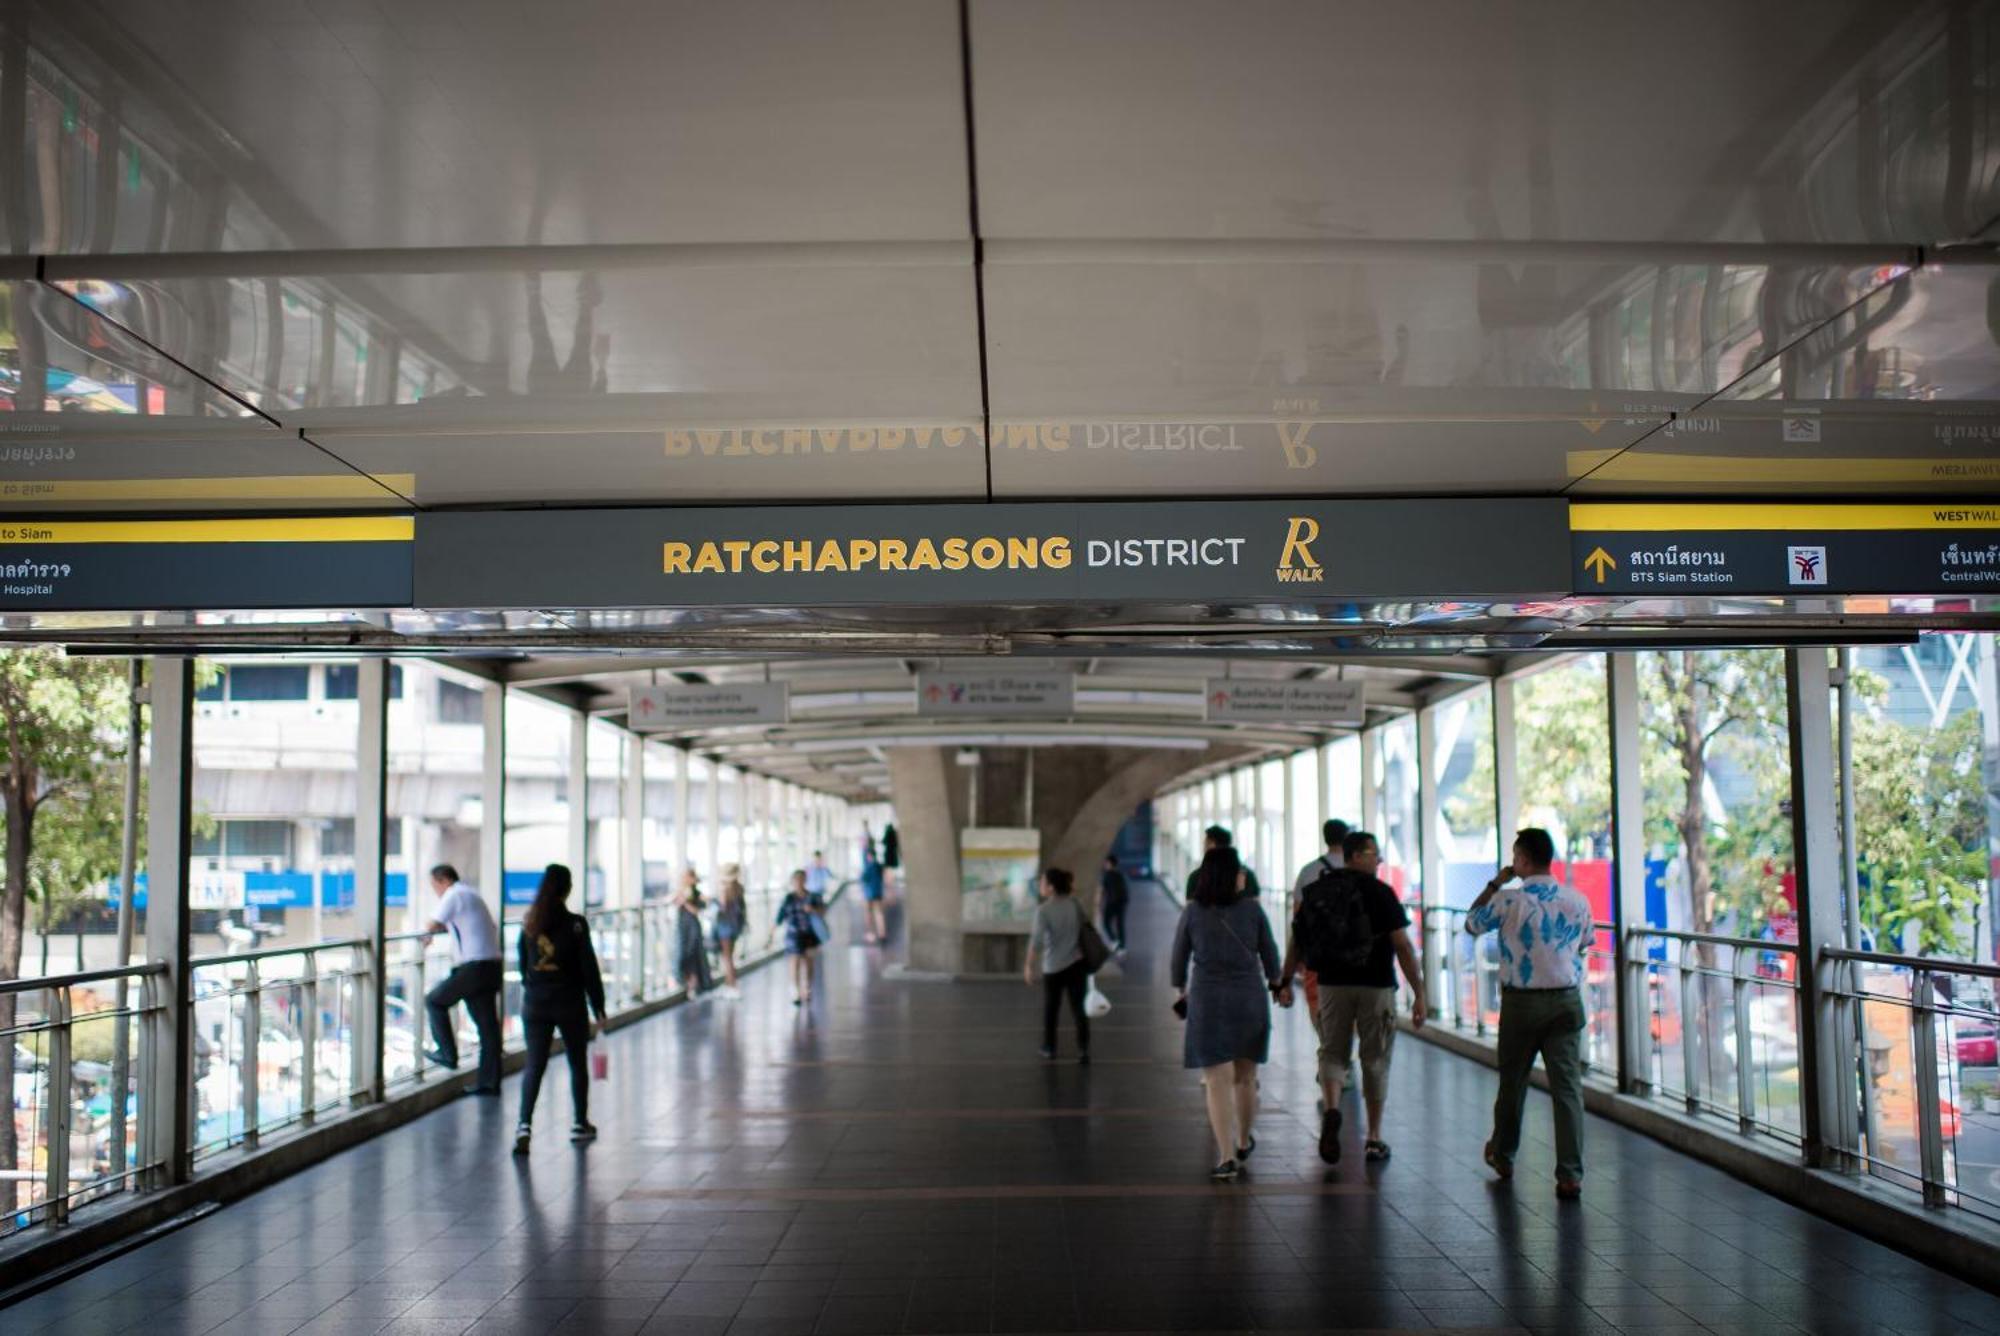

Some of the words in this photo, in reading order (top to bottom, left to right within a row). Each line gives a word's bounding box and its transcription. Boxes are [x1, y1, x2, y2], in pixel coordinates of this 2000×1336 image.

[2, 529, 16, 539] to
[20, 528, 53, 540] Siam
[1279, 517, 1320, 568] R
[663, 536, 1072, 573] RATCHAPRASONG
[1087, 538, 1246, 567] DISTRICT
[1630, 544, 1725, 565] สถานีสยาม
[1276, 568, 1324, 582] WALK
[1631, 572, 1654, 582] BTS
[1658, 572, 1687, 582] Siam
[1690, 572, 1733, 582] Station
[4, 584, 53, 596] Hospital
